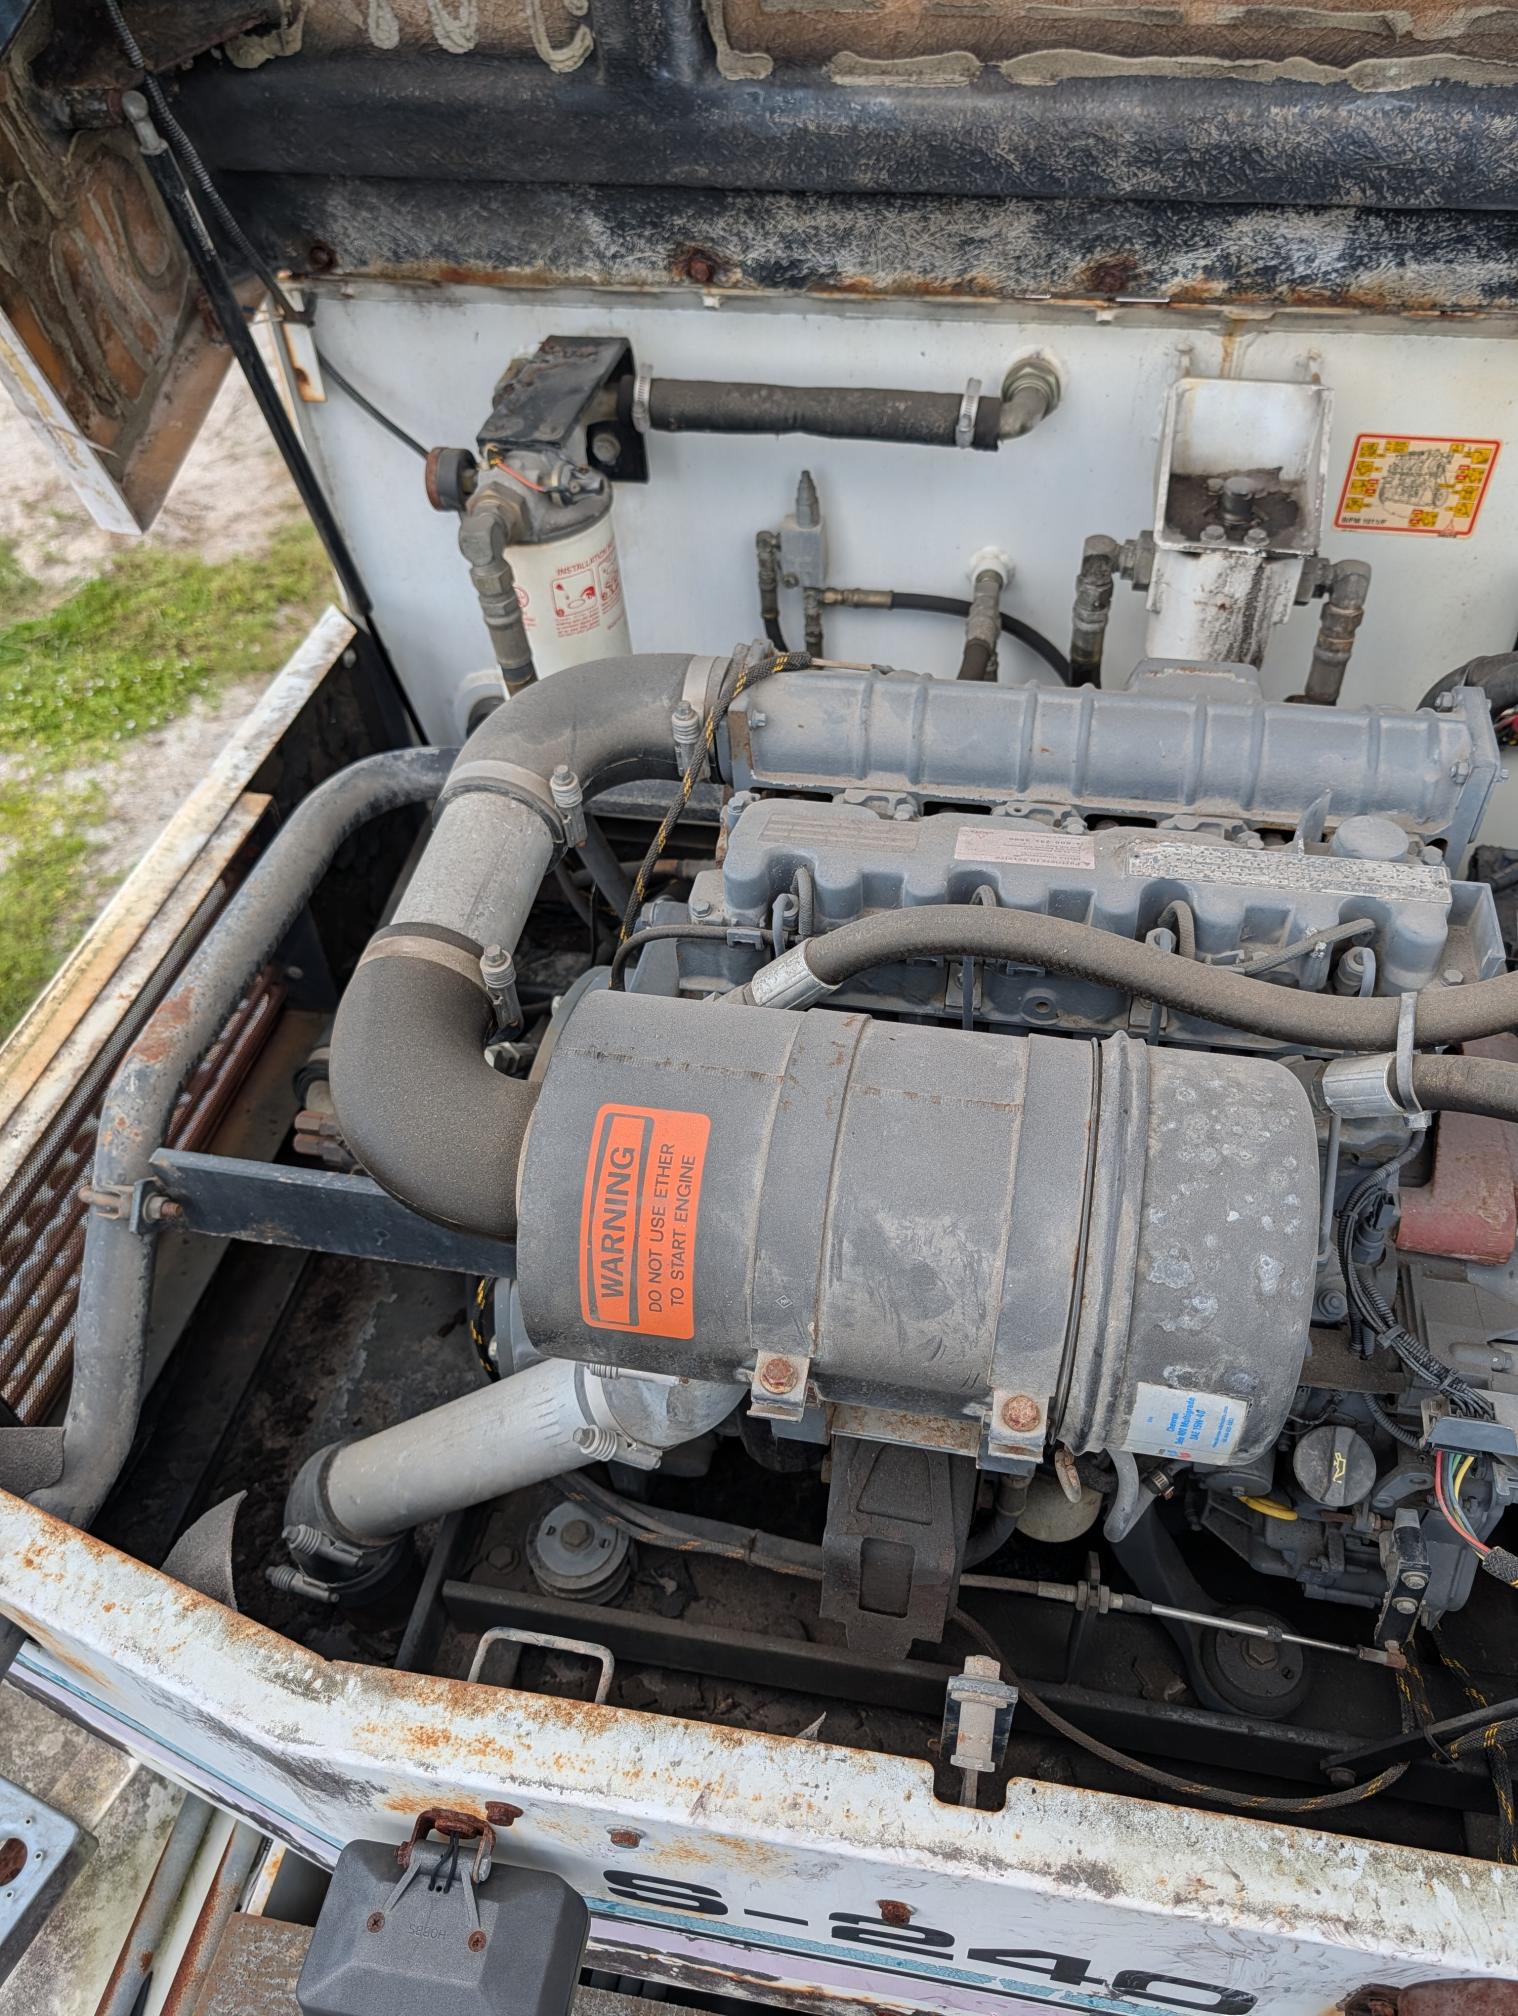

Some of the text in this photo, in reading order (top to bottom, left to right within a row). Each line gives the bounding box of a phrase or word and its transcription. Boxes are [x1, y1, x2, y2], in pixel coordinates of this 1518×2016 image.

[557, 549, 607, 576] INSTALLATION
[601, 1146, 636, 1299] WARNING
[647, 1143, 676, 1313] DO NOT USE ETHER
[670, 1154, 696, 1307] TO START ENGINE
